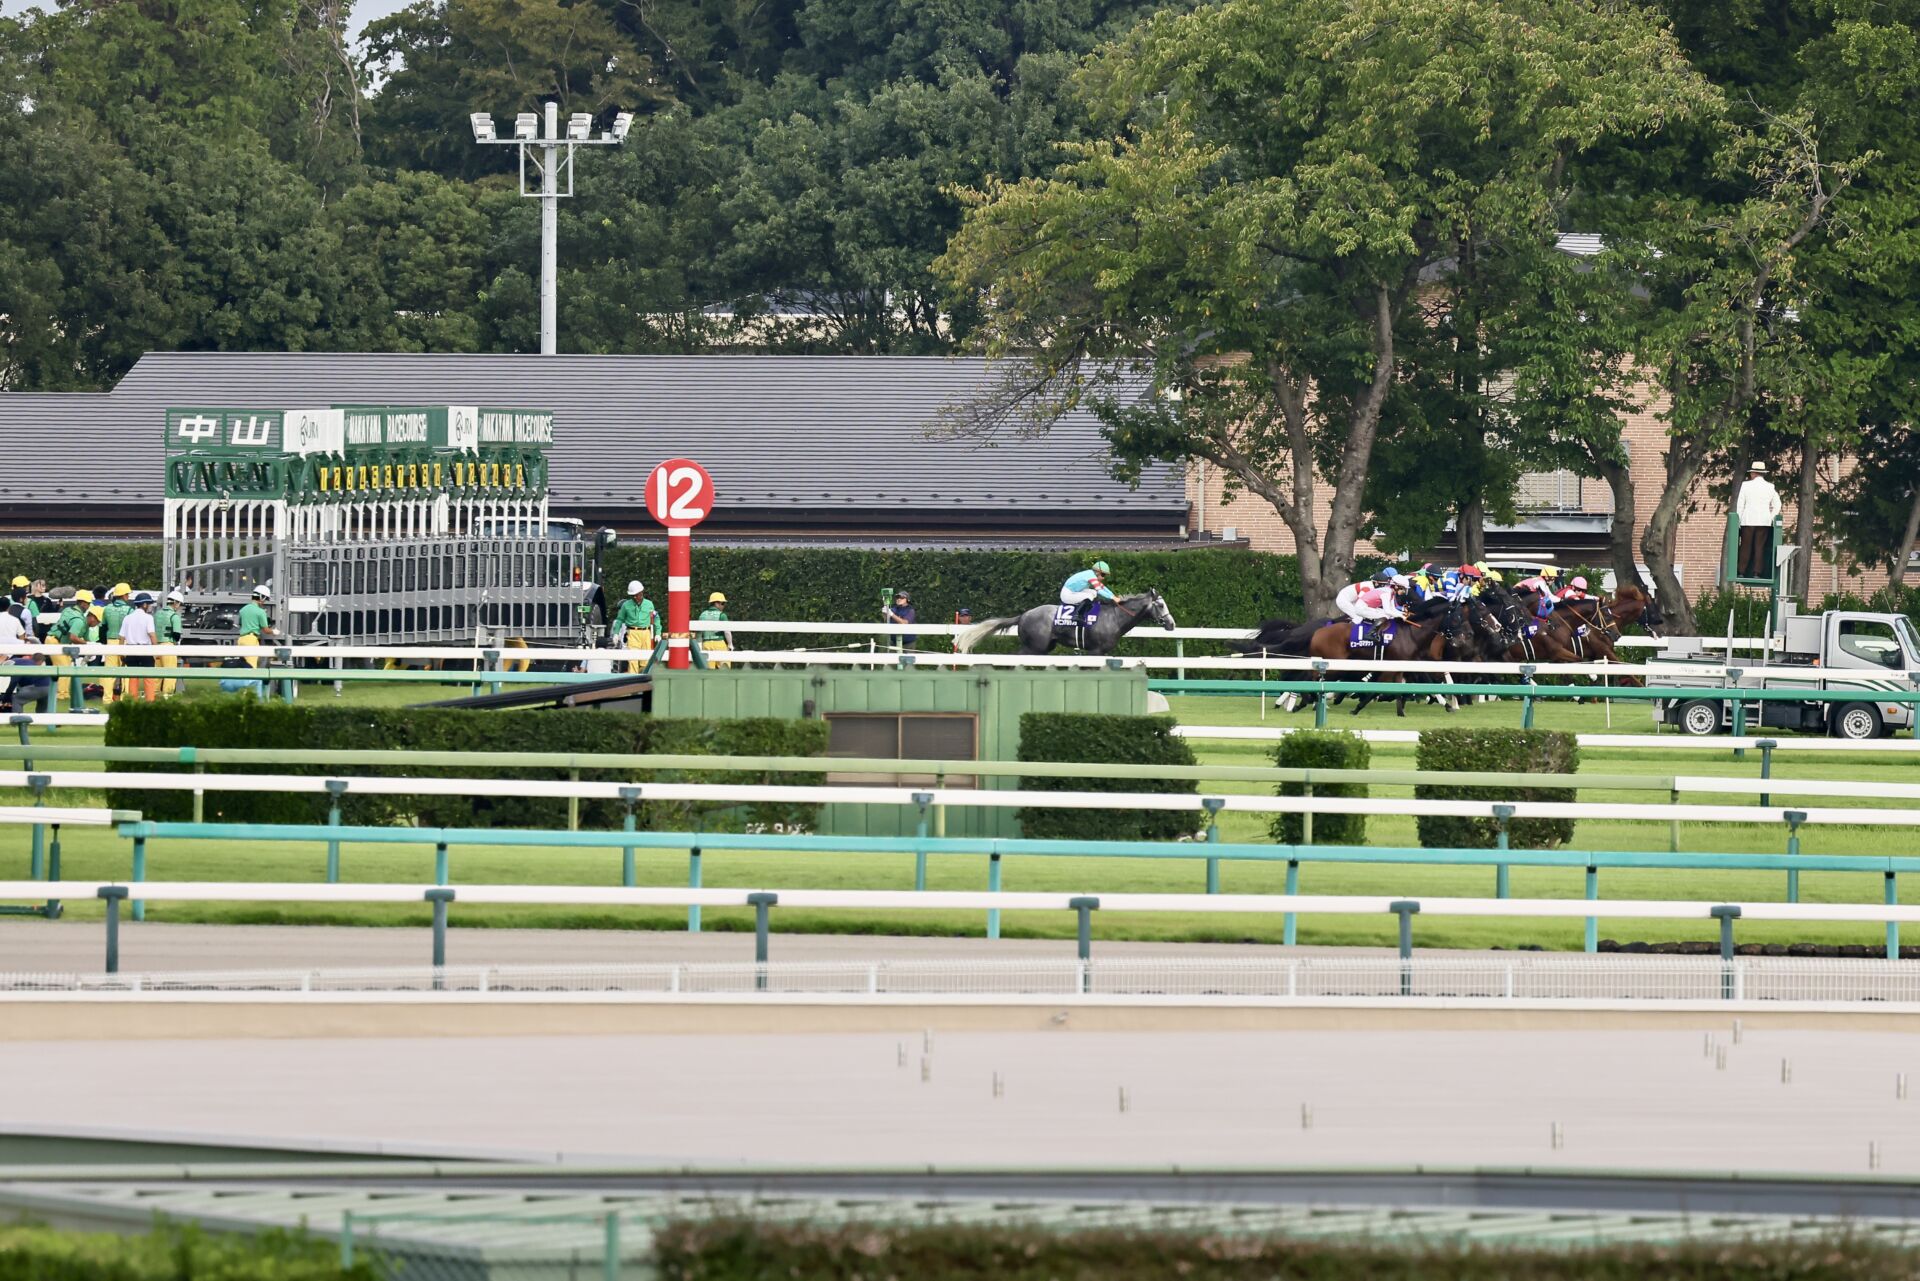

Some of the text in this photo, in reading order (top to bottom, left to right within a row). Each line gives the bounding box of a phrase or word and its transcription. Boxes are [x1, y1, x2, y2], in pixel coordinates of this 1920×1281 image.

[178, 415, 271, 444] 中山
[348, 413, 427, 444] NAKAYAMA RACECOURSE
[482, 413, 553, 443] NAKAYAMA RACECOURSE
[657, 467, 704, 519] 12
[1057, 605, 1075, 619] 12
[1358, 625, 1363, 640] 1
